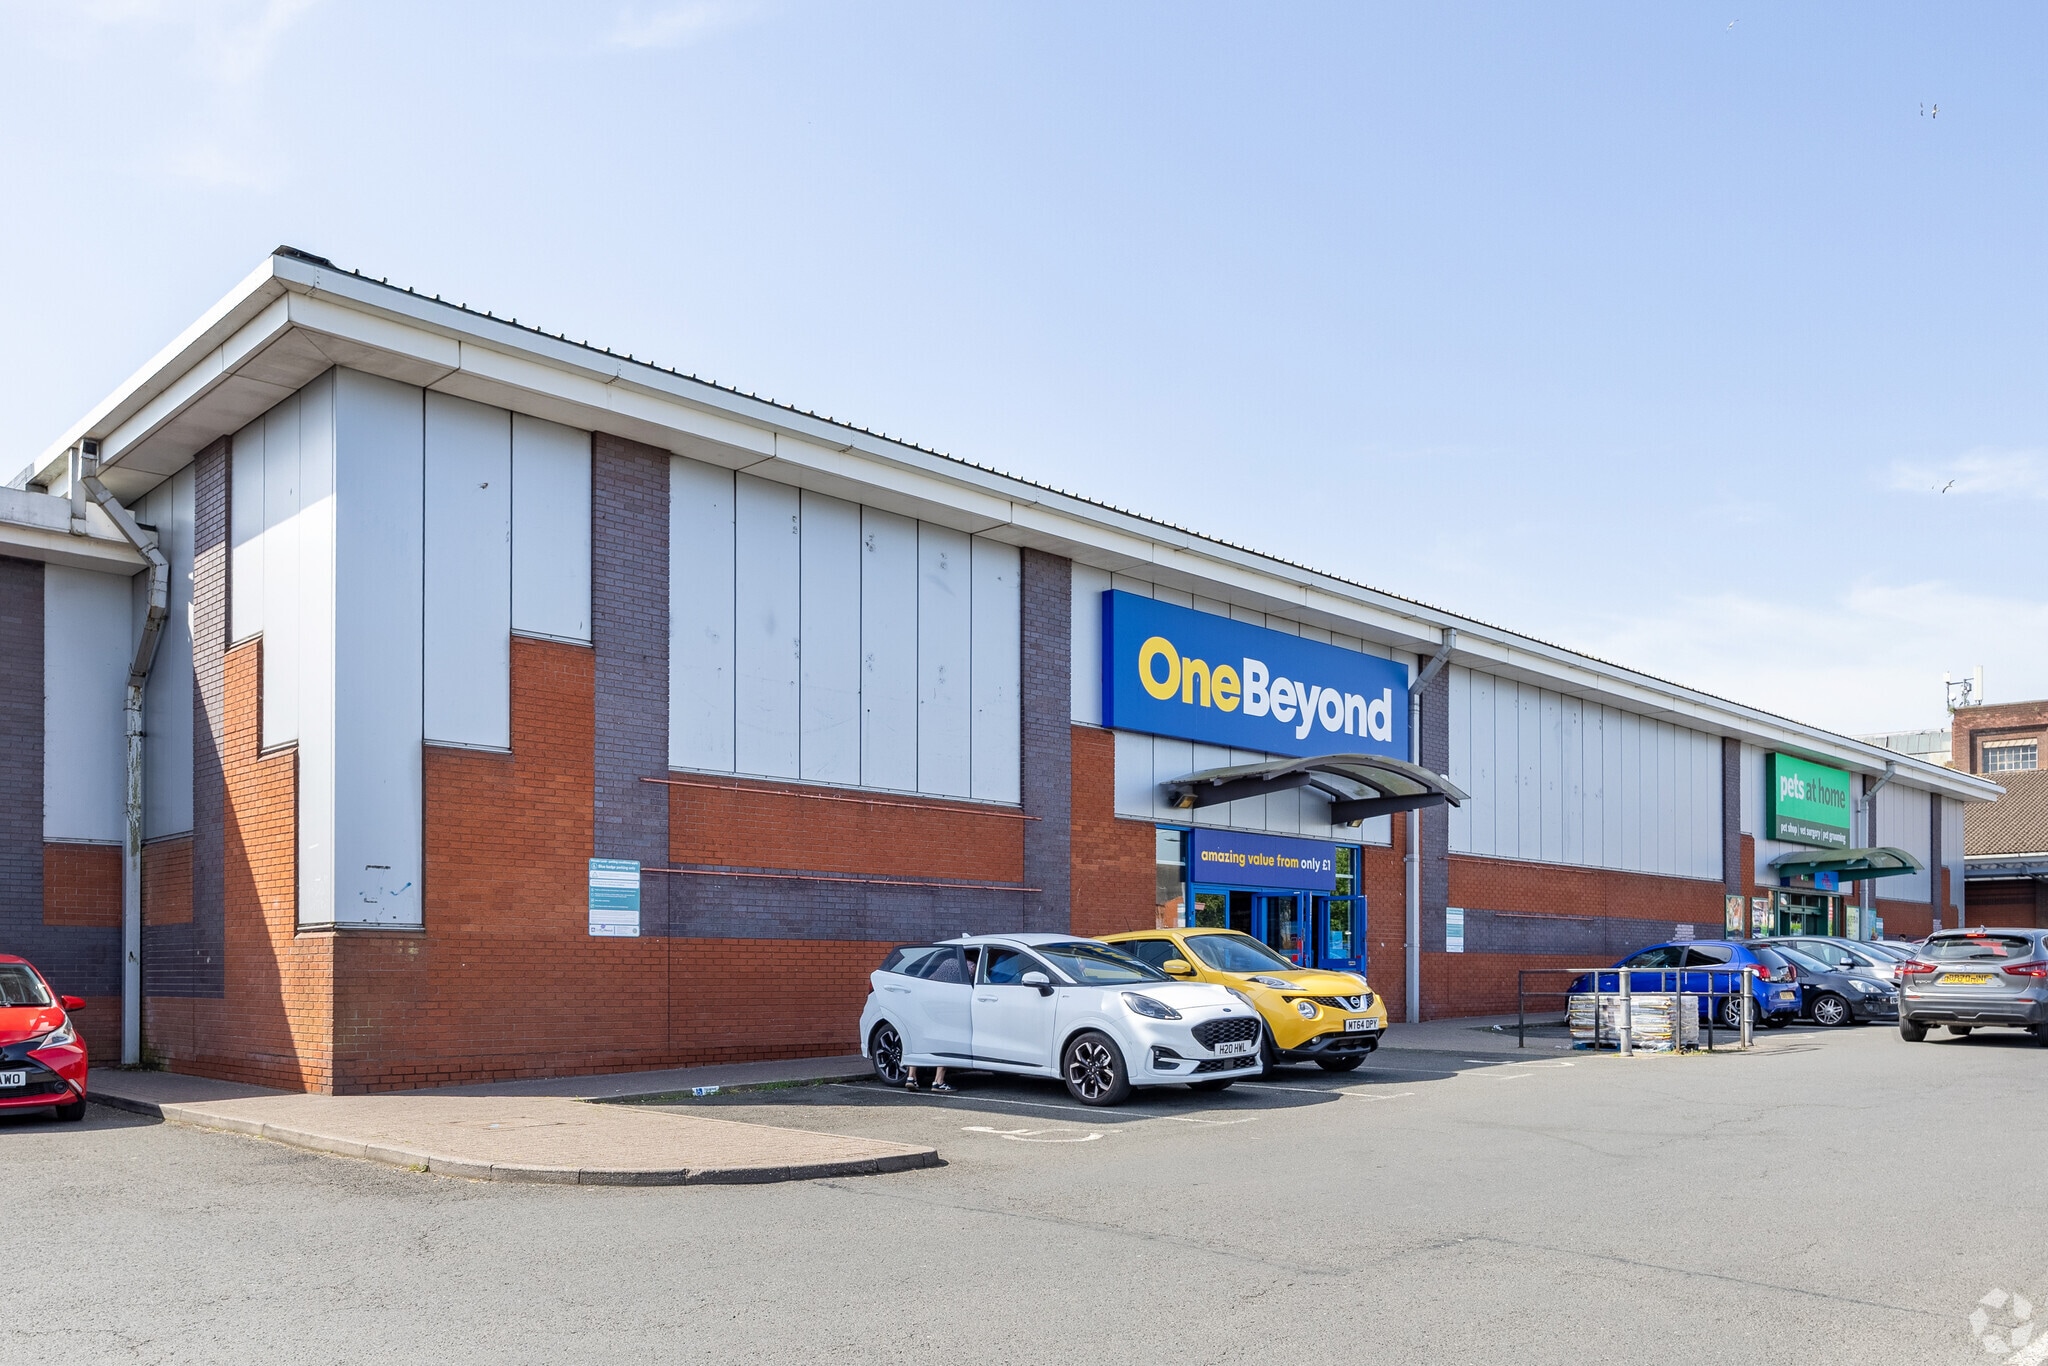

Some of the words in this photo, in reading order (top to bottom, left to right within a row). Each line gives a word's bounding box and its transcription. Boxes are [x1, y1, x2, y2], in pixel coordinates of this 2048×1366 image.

[1138, 636, 1392, 742] OneBeyond
[1780, 773, 1805, 802] pets
[1806, 778, 1817, 802] at
[1818, 777, 1846, 809] home
[1788, 822, 1798, 836] shop
[1806, 828, 1821, 840] surgery
[1829, 833, 1846, 845] grooming
[1201, 850, 1246, 867] amazing
[1248, 853, 1275, 867] value
[1277, 854, 1299, 868] from
[1300, 858, 1320, 872] only
[1322, 859, 1331, 871] £1
[1348, 1020, 1365, 1030] MT64
